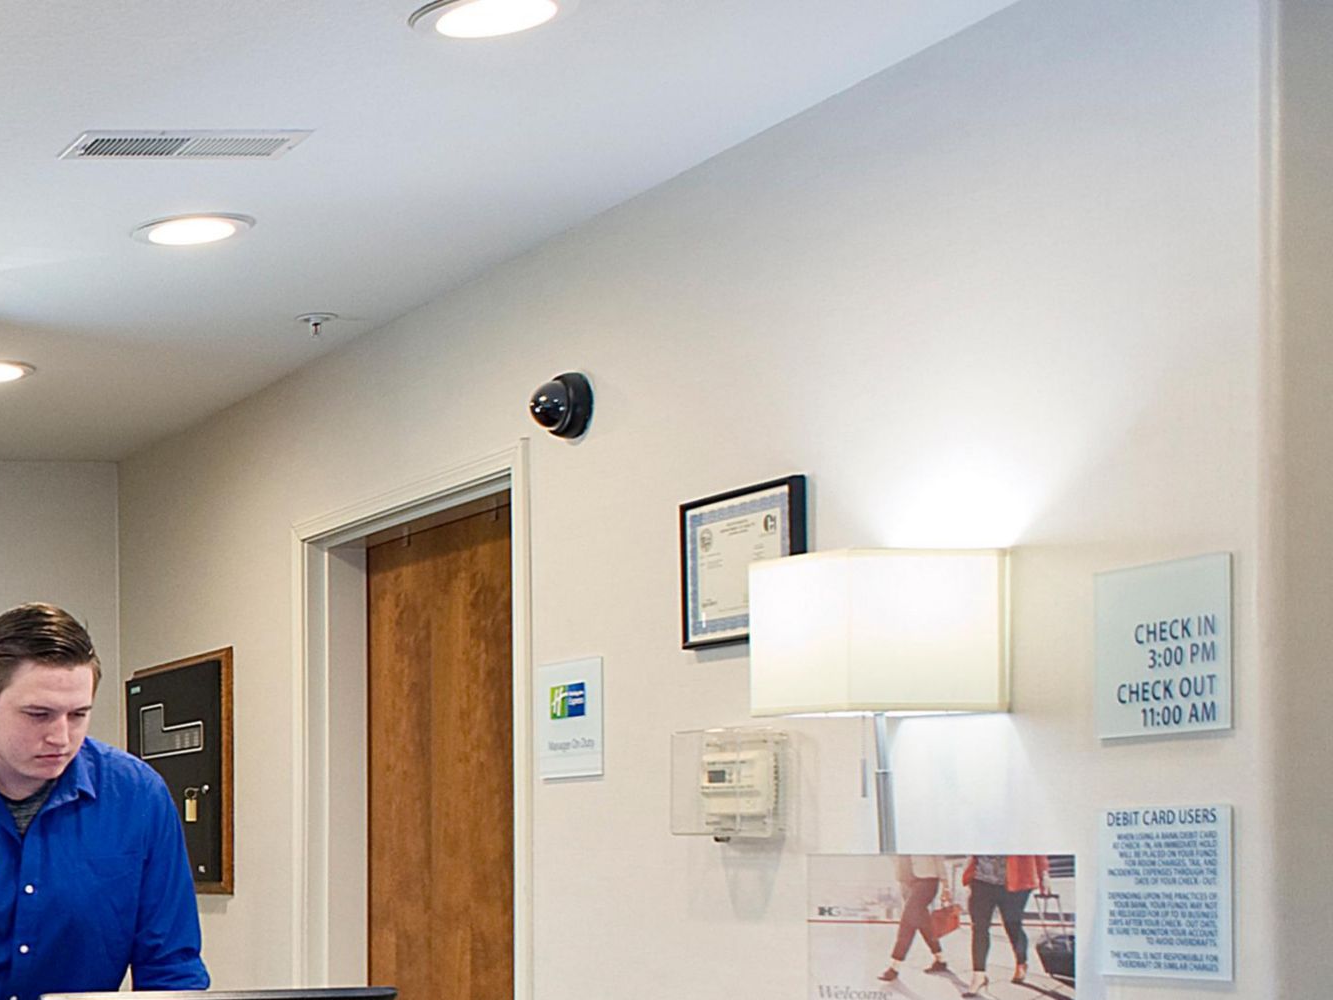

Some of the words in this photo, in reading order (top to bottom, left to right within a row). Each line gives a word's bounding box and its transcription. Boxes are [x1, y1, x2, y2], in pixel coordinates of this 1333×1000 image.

[1134, 617, 1192, 645] CHECK
[1197, 614, 1216, 637] IN
[1148, 646, 1183, 669] 3:00
[1189, 641, 1216, 664] PM
[1117, 679, 1173, 705] CHECK
[1179, 674, 1217, 698] OUT
[1141, 705, 1182, 727] 11:00
[1187, 701, 1216, 724] AM
[1107, 811, 1139, 827] DEBIT
[1142, 810, 1175, 826] CARD
[1179, 808, 1217, 824] USERS
[818, 985, 893, 1000] Welcome
